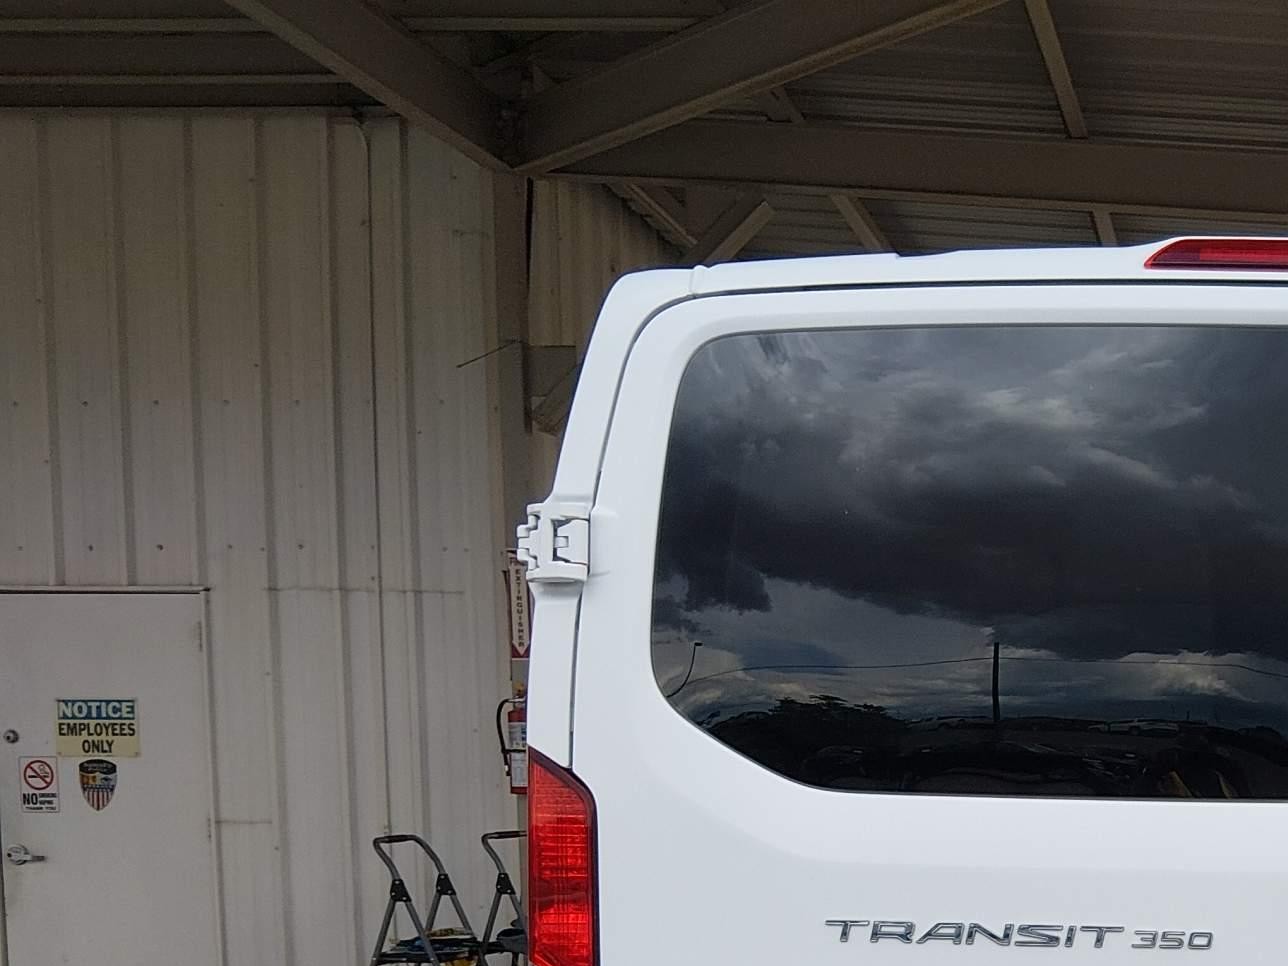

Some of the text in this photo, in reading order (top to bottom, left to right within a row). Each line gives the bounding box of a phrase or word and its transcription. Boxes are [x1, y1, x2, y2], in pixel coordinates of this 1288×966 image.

[58, 701, 135, 718] NOTICE
[58, 722, 136, 737] EMPLOYEES
[82, 739, 115, 754] ONLY
[22, 792, 38, 806] NO
[825, 919, 1214, 950] TRANSIT 350
